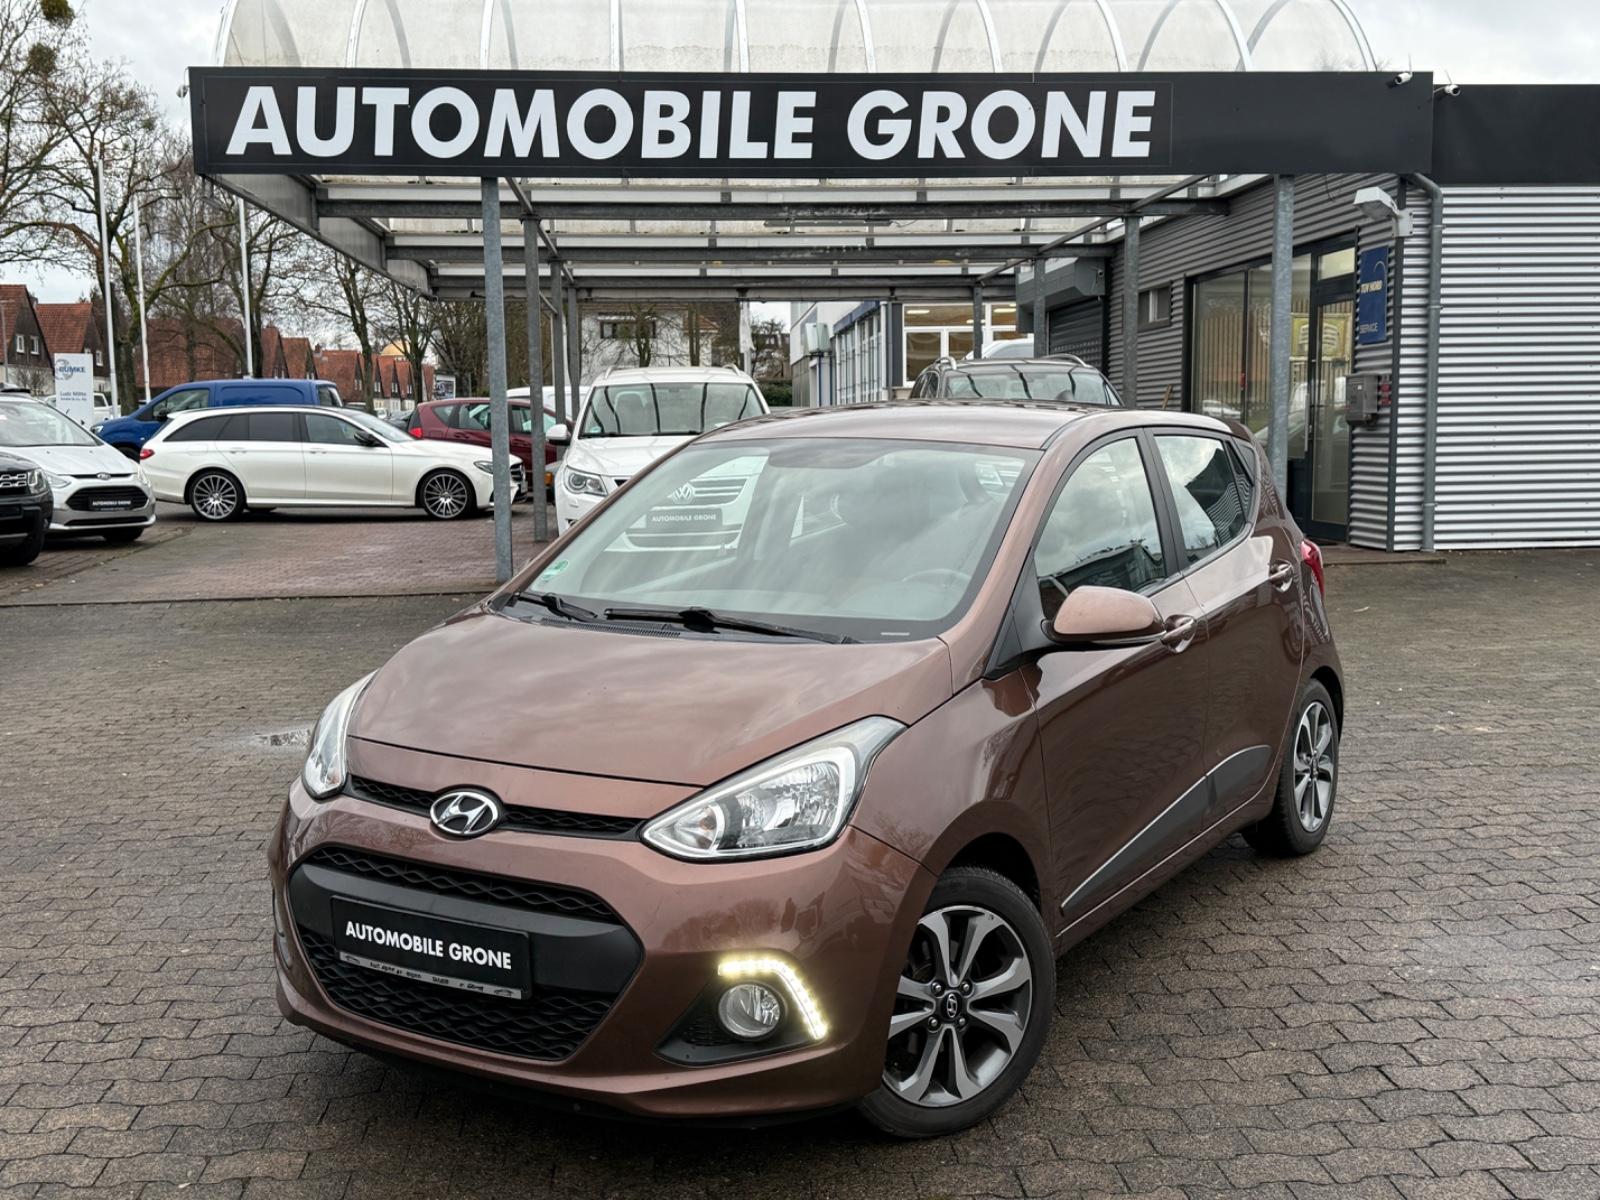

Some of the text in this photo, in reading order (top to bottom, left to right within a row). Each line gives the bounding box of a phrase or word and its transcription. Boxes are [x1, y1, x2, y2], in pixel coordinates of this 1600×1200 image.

[225, 86, 1156, 160] AUTOMOBILE GRONE
[652, 513, 717, 522] AUTOMOBILE GRONE
[345, 920, 512, 970] AUTOMOBILE GRONE
